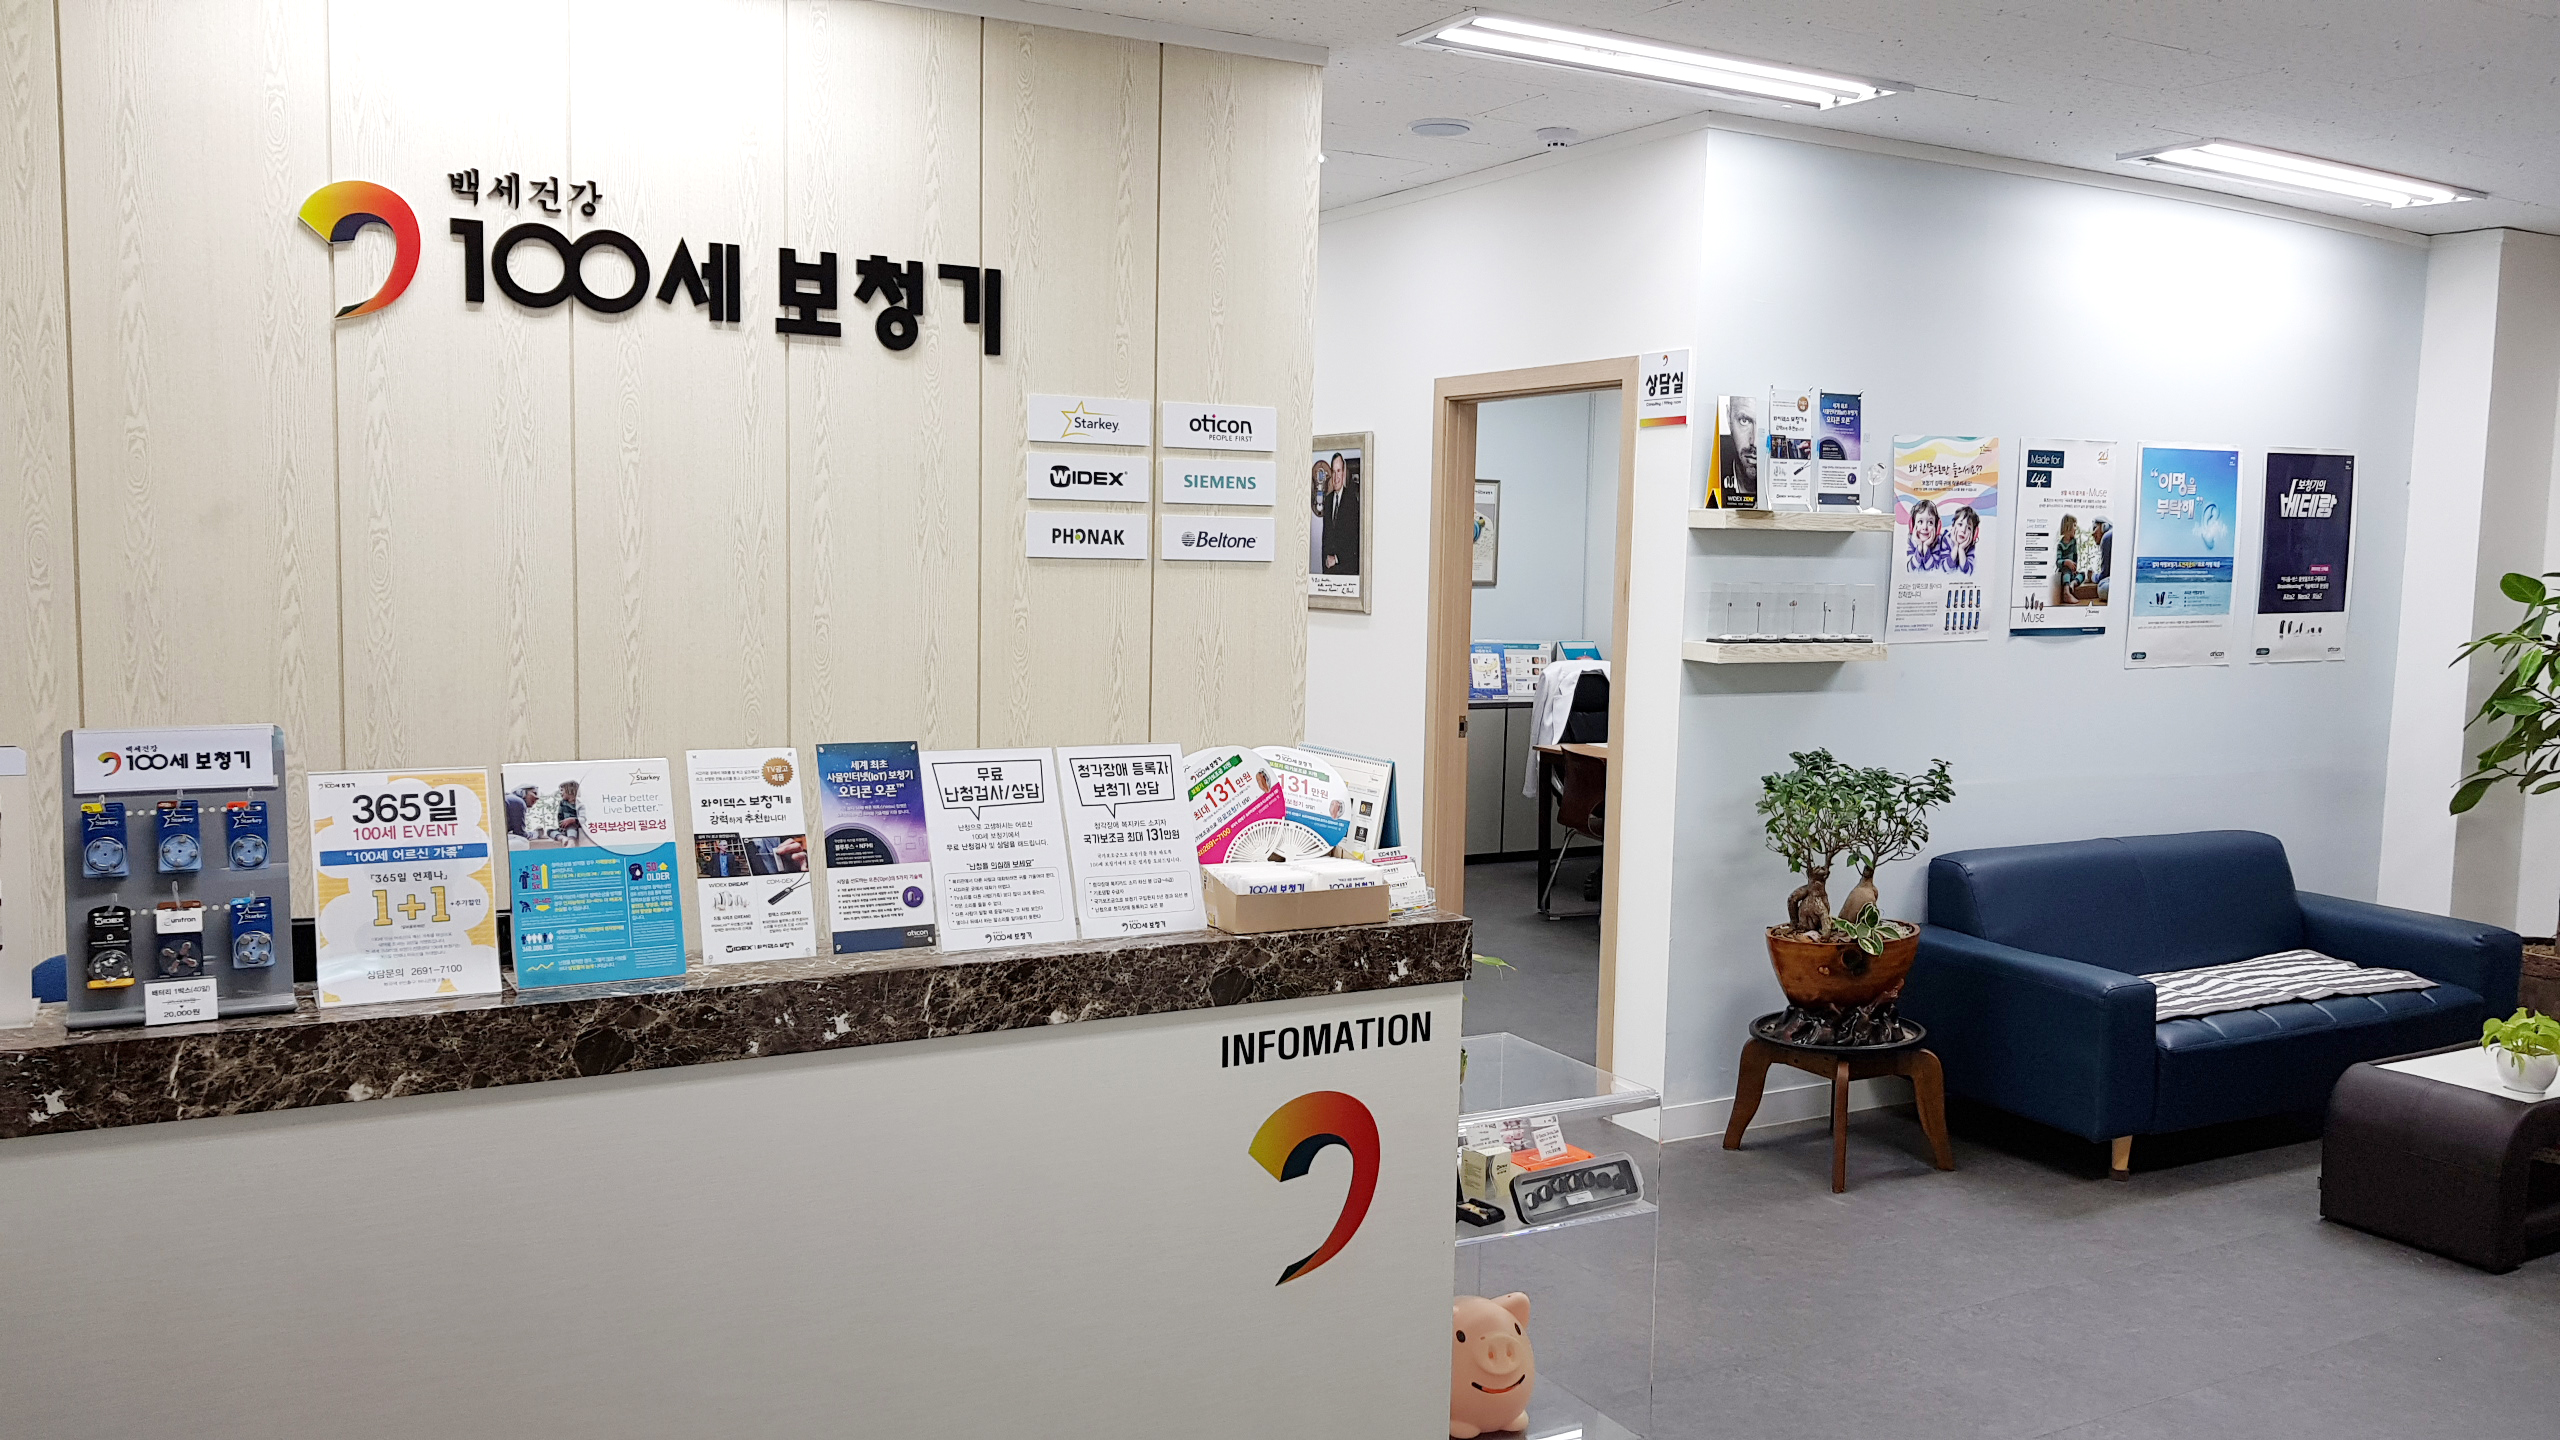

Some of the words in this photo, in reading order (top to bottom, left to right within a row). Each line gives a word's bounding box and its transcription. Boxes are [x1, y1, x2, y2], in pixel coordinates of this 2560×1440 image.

[449, 169, 602, 217] 백세건강
[450, 217, 740, 323] 100세
[775, 247, 1001, 355] 보청기
[1646, 372, 1683, 396] 상담실
[1074, 417, 1118, 432] Starkey
[1190, 414, 1252, 434] oticon
[2031, 455, 2049, 464] Made
[2051, 455, 2060, 464] for
[1909, 464, 1917, 473] 왜
[1184, 475, 1256, 489] SIEMENS
[2297, 480, 2326, 492] 보청기의
[2089, 488, 2107, 497] Muse
[2281, 479, 2337, 517] 베테랑
[1052, 528, 1124, 545] PHONAK
[1196, 531, 1256, 549] Beltone
[2021, 612, 2044, 622] Muse
[126, 753, 188, 771] 100세
[196, 750, 250, 770] 보청기
[851, 761, 868, 770] 세계
[870, 760, 888, 769] 최초
[888, 770, 913, 780] 보청기
[978, 768, 1003, 781] 무료
[1078, 764, 1127, 778] 청각장애
[1132, 761, 1168, 776] 등록자
[838, 786, 872, 798] 오티콘
[944, 784, 1039, 802] 난청검사/상담
[1093, 783, 1131, 798] 보청기
[1135, 781, 1159, 795] 상담
[1278, 774, 1307, 794] 131
[1311, 788, 1328, 799] 만원
[602, 794, 626, 802] Hear
[701, 798, 746, 808] 와이덱스
[750, 795, 791, 808] 보청기를
[1194, 804, 1210, 820] 최대
[1206, 777, 1236, 807] 131
[1236, 772, 1252, 787] 만원
[352, 790, 457, 823] 365일
[604, 806, 622, 814] Live
[588, 821, 636, 833] 청력보상의
[638, 819, 667, 830] 필요성
[710, 815, 742, 825] 강력하게
[1094, 822, 1119, 830] 청각장애
[1122, 820, 1146, 828] 복지카드
[353, 829, 396, 840] 100세
[404, 824, 458, 838] EVENT
[1084, 833, 1124, 844] 국가보조금
[1128, 832, 1143, 841] 최대
[1146, 828, 1180, 841] 131만원
[393, 849, 428, 860] 어르신
[647, 872, 670, 881] OLDER
[368, 968, 404, 979] 상담문의
[164, 1009, 200, 1017] 20,000원
[1221, 1011, 1431, 1068] INFOMATION
